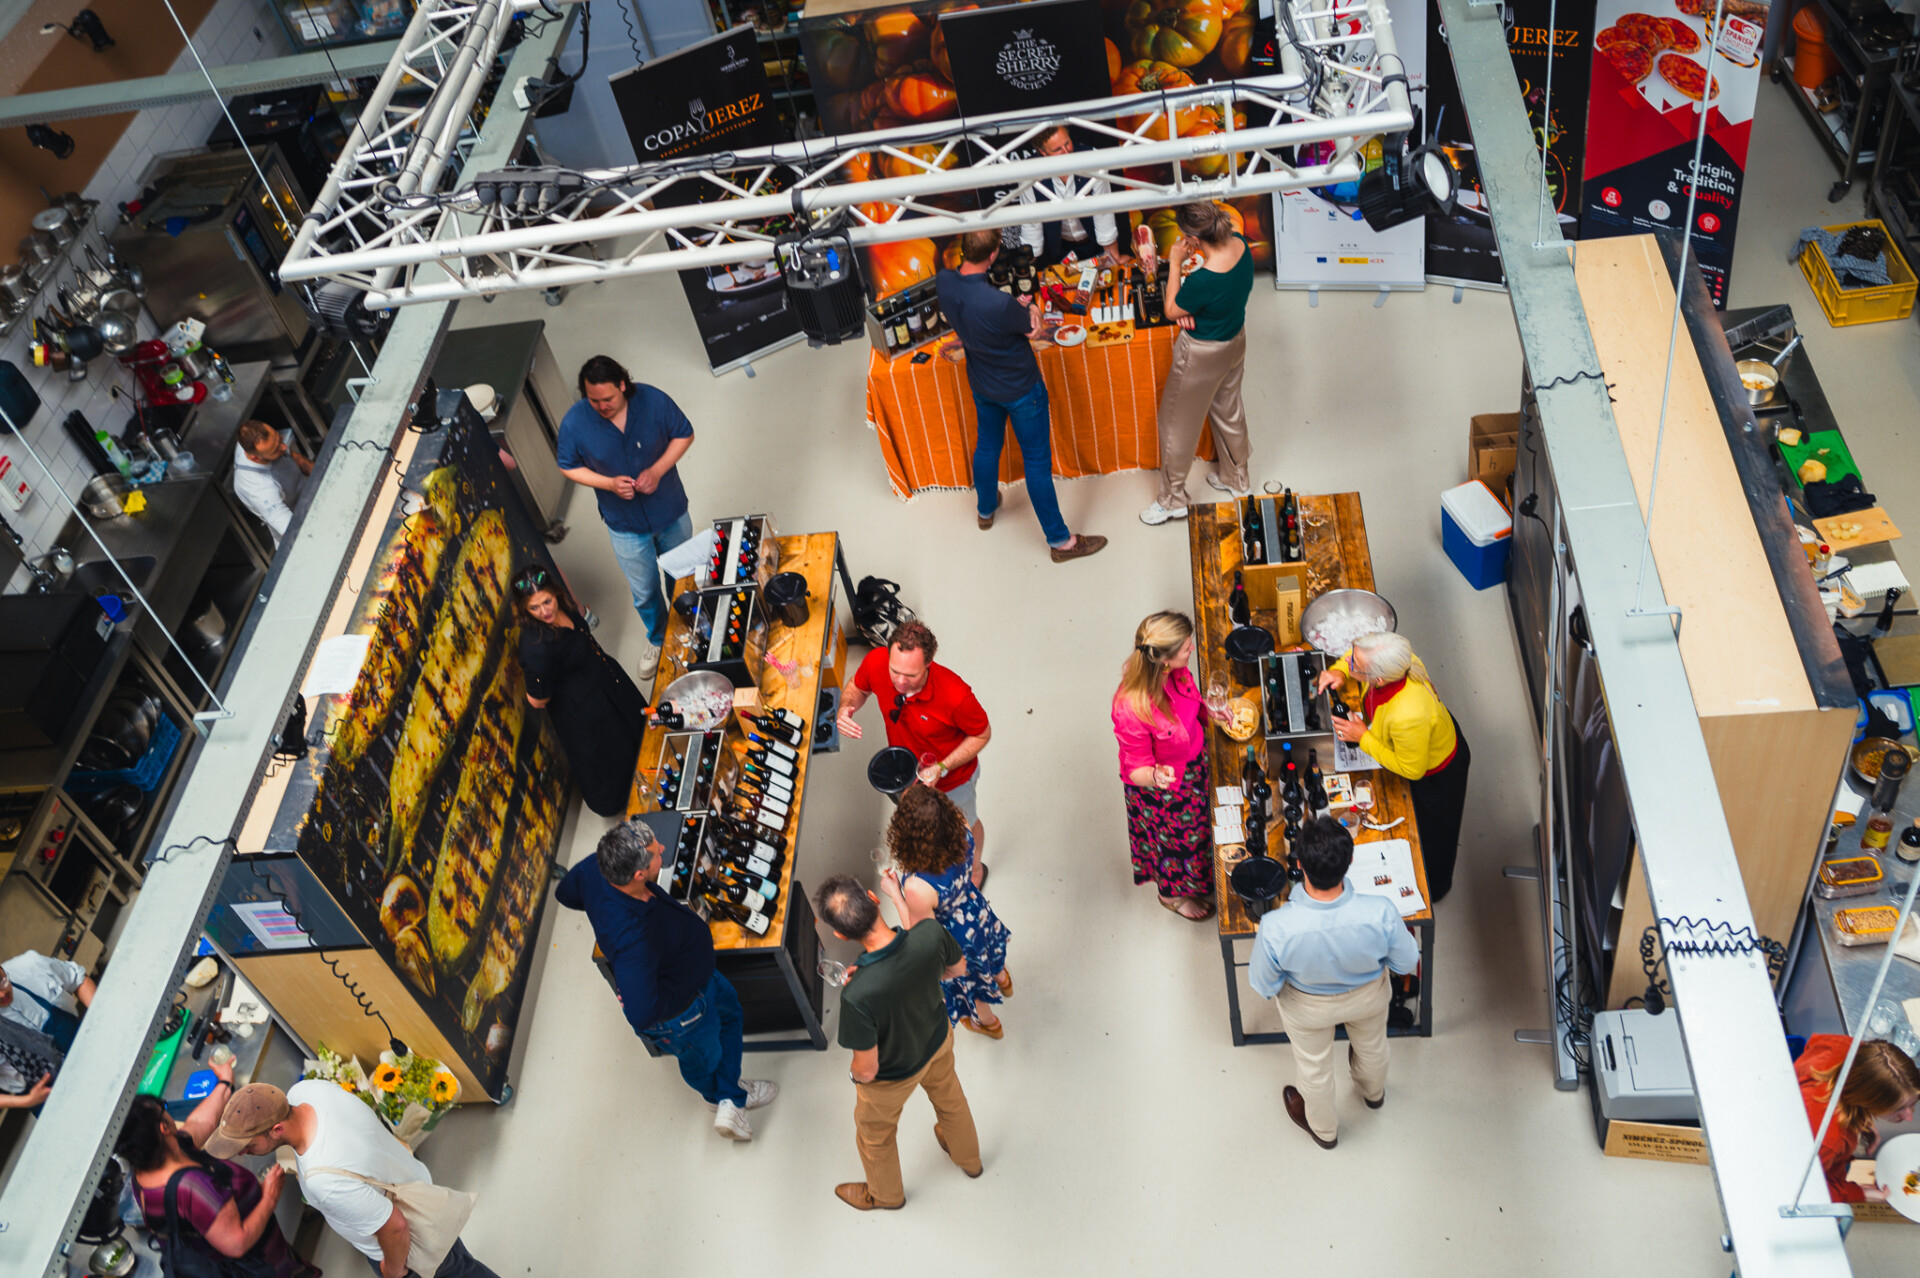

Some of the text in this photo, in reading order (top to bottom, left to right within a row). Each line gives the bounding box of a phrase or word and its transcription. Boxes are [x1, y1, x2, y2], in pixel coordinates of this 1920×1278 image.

[1014, 39, 1037, 49] THE
[1512, 26, 1579, 47] JEREZ
[1722, 36, 1751, 53] CHORIZO
[1725, 28, 1754, 46] SPANISH
[998, 44, 1056, 62] SECRET
[996, 55, 1062, 75] SHERRY
[1010, 74, 1052, 90] SOCIETY
[644, 93, 764, 151] COPA JEREZ
[1688, 159, 1736, 183] Origin,
[1673, 168, 1735, 195] Tradition
[1667, 181, 1733, 209] & Quality
